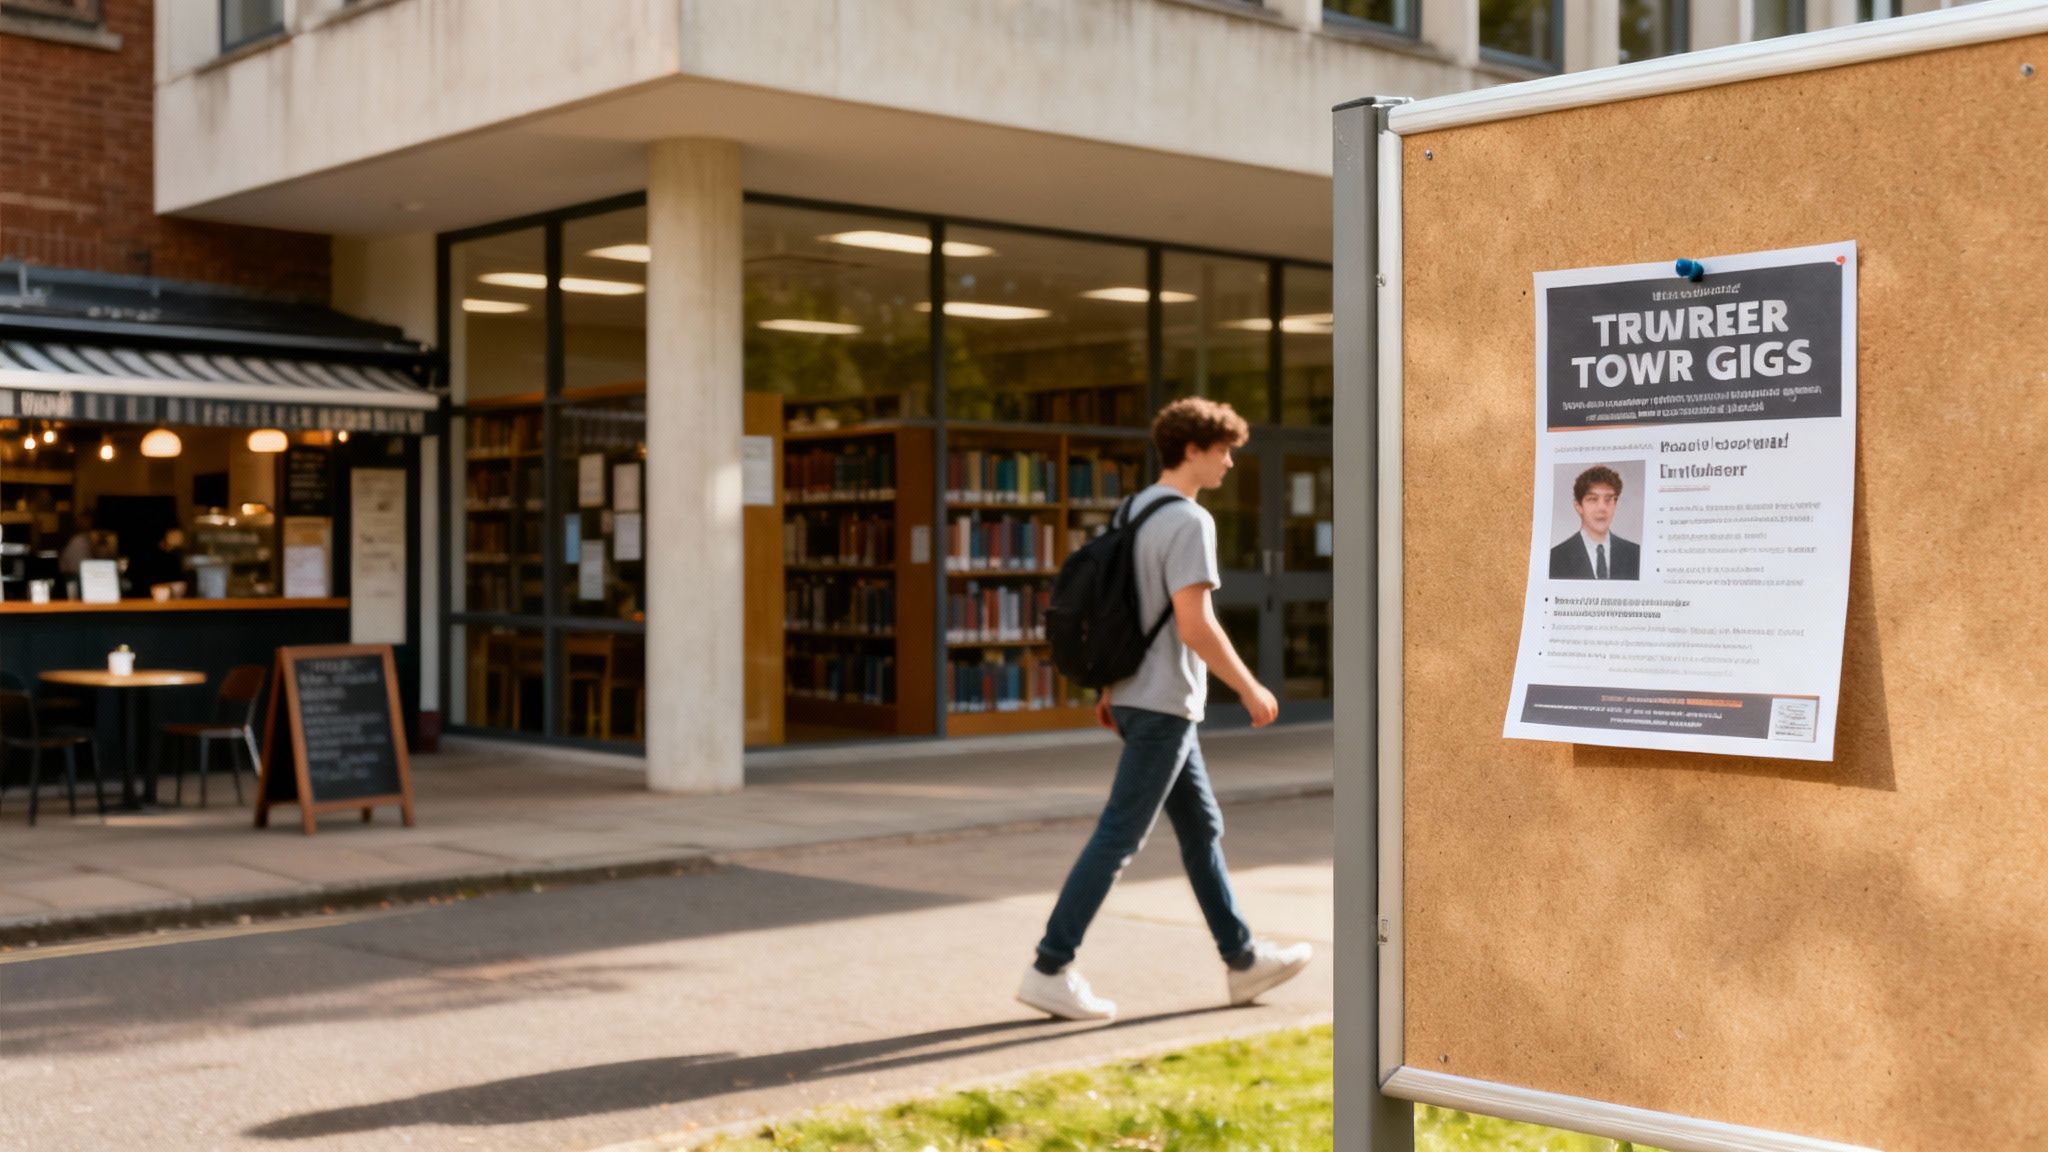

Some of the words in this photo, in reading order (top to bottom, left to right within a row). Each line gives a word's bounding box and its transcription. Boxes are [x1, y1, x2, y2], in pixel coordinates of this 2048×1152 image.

[1592, 299, 1789, 347] TRWREER
[1571, 349, 1694, 389] TOWR
[1707, 339, 1813, 381] GIGS
